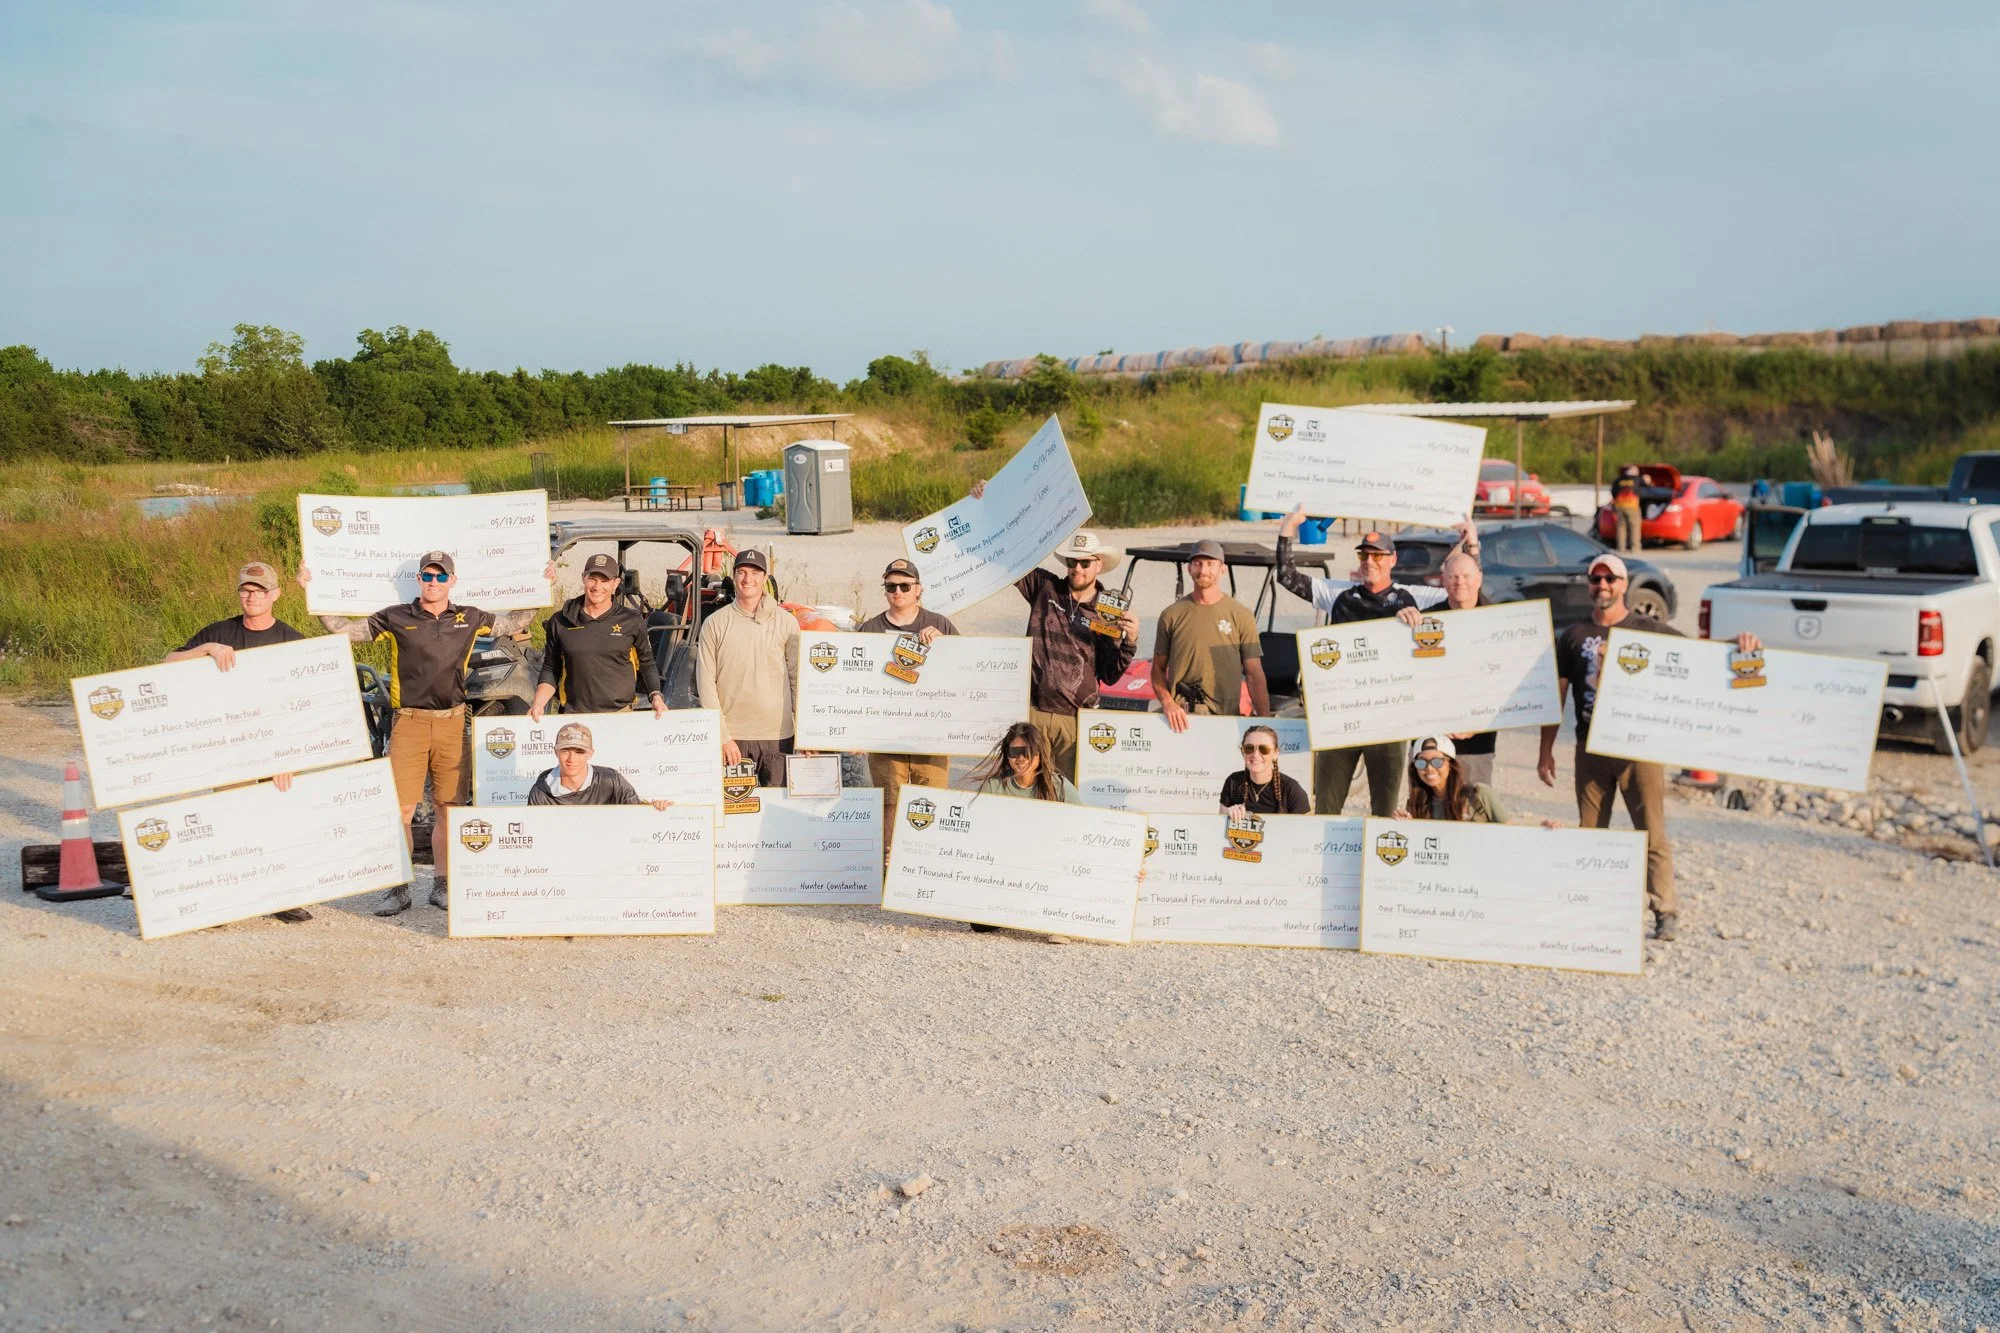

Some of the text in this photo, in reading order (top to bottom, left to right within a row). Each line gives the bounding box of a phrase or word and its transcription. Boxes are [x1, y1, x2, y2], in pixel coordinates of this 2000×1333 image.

[1298, 431, 1326, 439] HUNTER
[1278, 471, 1310, 482] Thousand
[490, 515, 535, 528] 05/17/2026
[944, 523, 970, 539] HUNTER
[954, 505, 1032, 562] 3rd Place Defensive Competition
[354, 550, 366, 558] 3rd
[369, 549, 387, 558] Place
[486, 547, 505, 557] 1,000
[337, 568, 373, 578] Thousand
[376, 569, 390, 577] and
[393, 570, 416, 581] 0/100
[341, 589, 358, 598] BELT
[466, 585, 535, 598] Hunter Constantine
[950, 588, 965, 601] BELT
[1099, 594, 1127, 610] BELT
[898, 638, 928, 655] BELT
[811, 649, 836, 657] BELT
[1347, 650, 1378, 658] HUNTER
[290, 661, 340, 678] 05/17/2026
[976, 660, 1018, 672] 05/17/2026
[1354, 673, 1413, 688] 3rd Place Senior
[846, 686, 956, 699] 2nd Place Defensive Competition
[969, 691, 987, 700] 2,500
[131, 695, 168, 707] HUNTER
[289, 700, 311, 712] 2,500
[1322, 702, 1337, 713] Five
[1340, 699, 1372, 709] Hundred
[1374, 697, 1388, 705] and
[812, 705, 951, 720] Two Thousand Five Hundred and 0/100
[142, 708, 261, 736] 2nd Place Defensive Practical
[1344, 720, 1362, 731] BELT
[829, 727, 847, 735] BELT
[487, 735, 514, 743] BELT
[664, 733, 708, 746] 05/17/2026
[948, 732, 1003, 742] Hunter Constant
[526, 771, 536, 779] 1st
[659, 765, 678, 775] 5,000
[724, 764, 755, 777] ELT
[1125, 766, 1210, 778] 1st Place First Responder
[132, 773, 154, 786] BELT
[332, 786, 381, 804] 05/17/2026
[492, 792, 507, 801] Five
[1107, 785, 1141, 795] Thousand
[1144, 786, 1157, 795] Two
[1160, 787, 1189, 796] Hundred
[1192, 787, 1210, 798] Fifty
[909, 804, 935, 814] BELT
[828, 812, 870, 821] 05/17/2026
[939, 818, 970, 829] HUNTER
[177, 825, 213, 838] HUNTER
[332, 827, 347, 838] 750
[462, 826, 491, 835] BELT
[652, 830, 701, 841] 05/17/2026
[499, 836, 533, 844] HUNTER
[1083, 834, 1131, 848] 05/17/2026
[728, 842, 758, 851] Defensive
[822, 841, 840, 851] 5,000
[1165, 843, 1198, 851] HUNTER
[1314, 842, 1363, 853] 05/17/2026
[188, 845, 264, 867] 2nd Place Military
[939, 848, 995, 865] 2nd Place Lady
[1414, 852, 1449, 861] HUNTER
[504, 866, 548, 877] High Junior
[646, 865, 659, 875] 500
[1072, 866, 1091, 876] 1,500
[1169, 872, 1222, 885] 1st Place Lady
[1307, 876, 1328, 886] 2,500
[801, 882, 824, 890] Hunter
[827, 882, 867, 890] Constantine
[1418, 882, 1478, 898] 3rd Place Lady
[466, 888, 566, 898] Five Hundred and 0/100
[917, 889, 936, 899] BELT
[1567, 893, 1589, 903] 1,000
[1150, 894, 1188, 904] Thousand
[1192, 895, 1206, 904] Five
[1210, 896, 1243, 905] Hundred
[1246, 897, 1261, 905] and
[487, 911, 507, 921] BELT
[623, 909, 697, 919] Hunter Constantine
[1043, 908, 1116, 925] Hunter Constantine
[1396, 904, 1437, 917] Thousand
[1440, 908, 1456, 917] and
[1459, 910, 1485, 920] 0/100
[1153, 916, 1170, 926] BELT
[1284, 922, 1358, 932] Hunter Constantine
